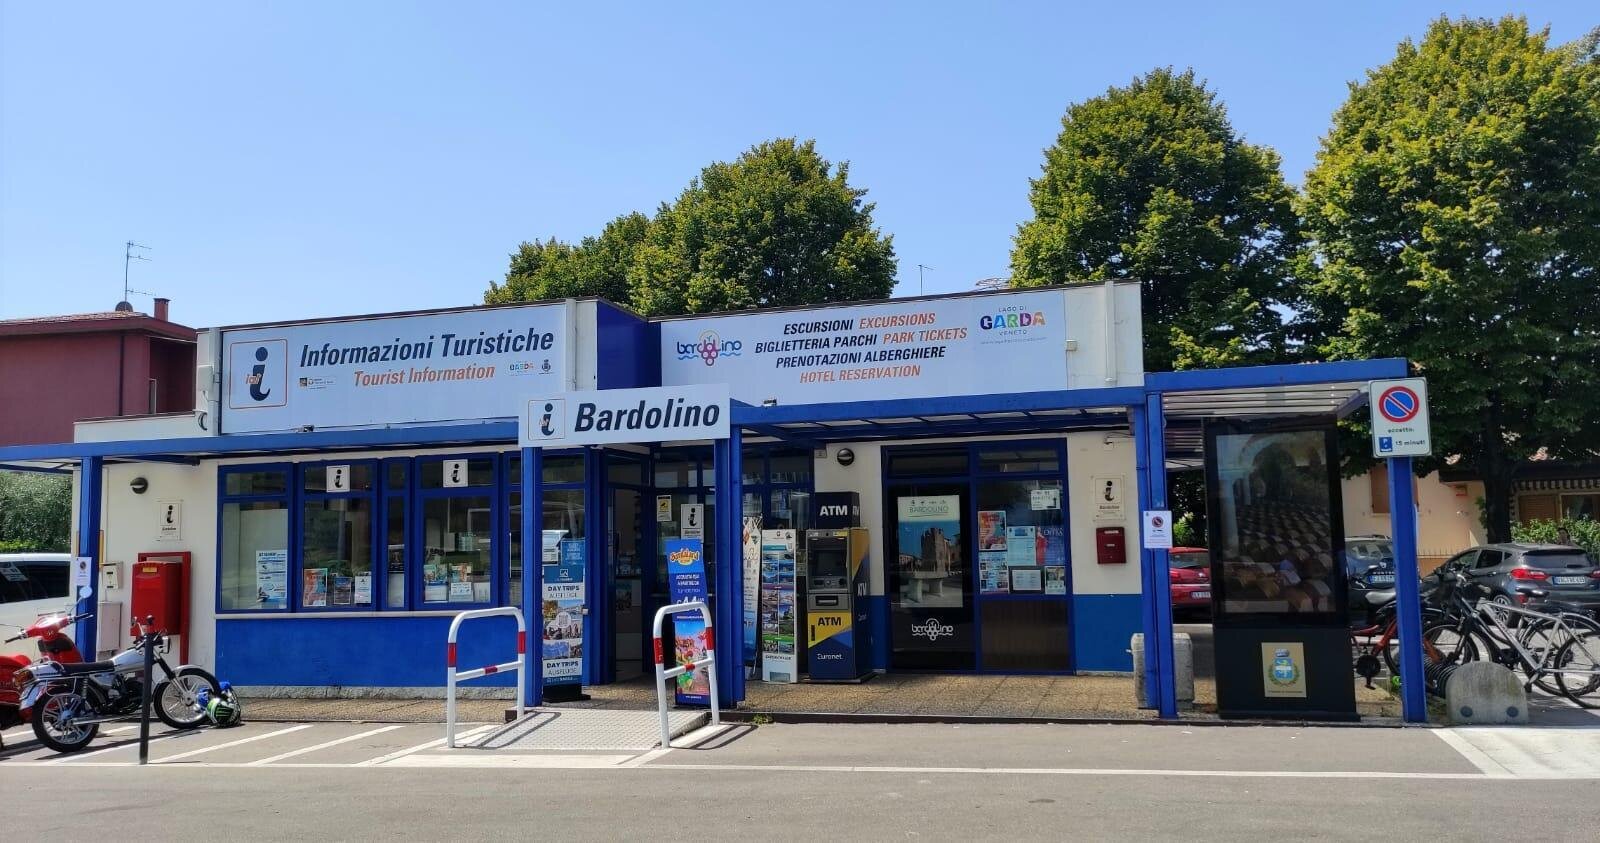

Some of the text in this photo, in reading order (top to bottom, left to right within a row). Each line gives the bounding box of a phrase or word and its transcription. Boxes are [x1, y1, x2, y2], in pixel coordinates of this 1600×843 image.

[783, 312, 936, 335] ESCURSIONI EXCURSIONS
[980, 311, 1046, 330] GARDA
[300, 327, 554, 368] Informazioni Turistiche
[755, 337, 830, 353] BIGLIETTERIA
[833, 334, 877, 348] PARCHI
[883, 331, 915, 344] PARK
[919, 327, 967, 341] TICKETS
[776, 346, 946, 368] PRENOTAZIONI ALBERGHIERE
[354, 368, 406, 387] Tourist
[408, 363, 496, 384] Information
[800, 364, 921, 383] HOTEL RESERVATION
[574, 398, 720, 433] Bardolino
[819, 504, 848, 516] ATM
[817, 616, 842, 626] ATM
[561, 660, 579, 668] TRIPS
